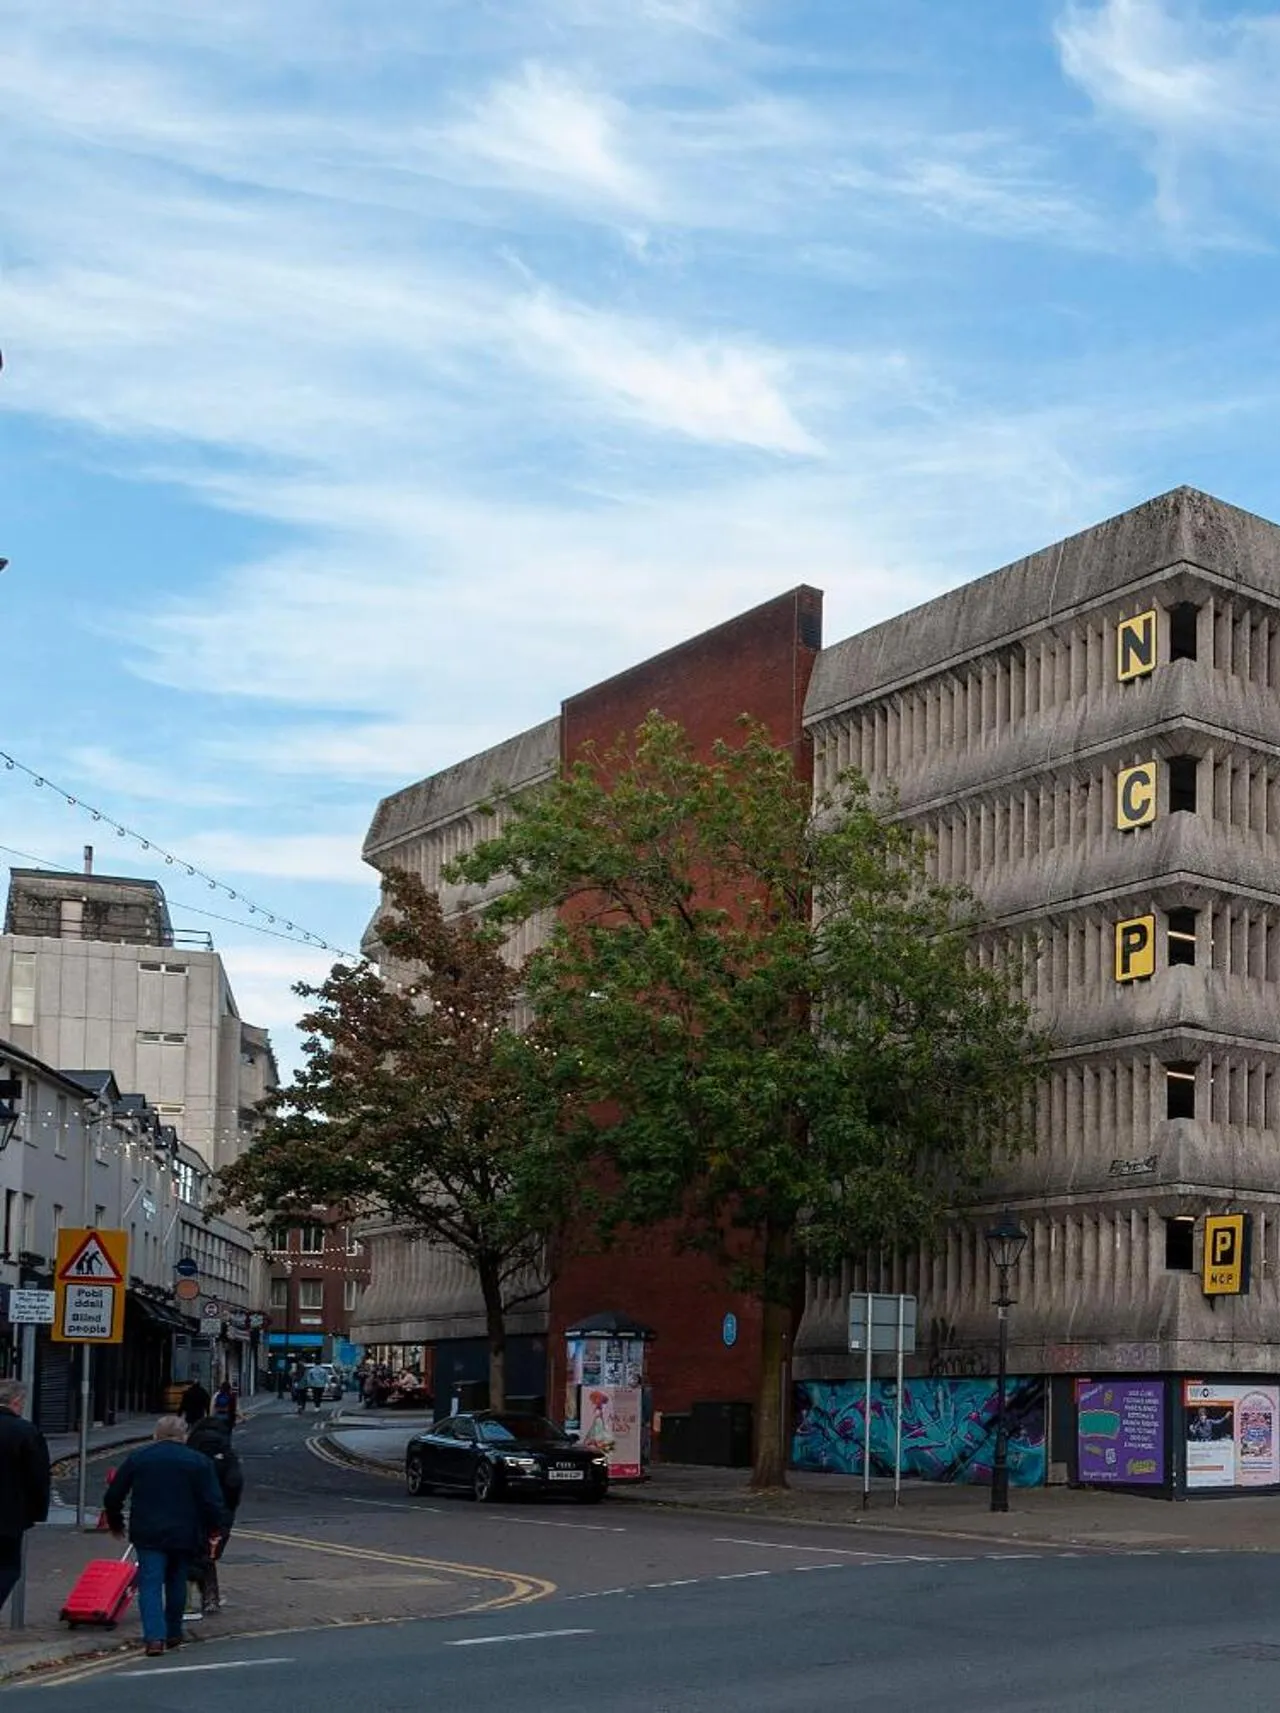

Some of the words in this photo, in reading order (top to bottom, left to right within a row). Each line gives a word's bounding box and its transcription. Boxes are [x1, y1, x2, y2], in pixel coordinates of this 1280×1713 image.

[1121, 617, 1152, 675] N
[1121, 770, 1151, 821] C
[1121, 922, 1147, 973] P
[1216, 1231, 1232, 1262] P
[1210, 1273, 1233, 1284] NCP
[68, 1325, 107, 1334] people
[72, 1313, 101, 1322] Blind
